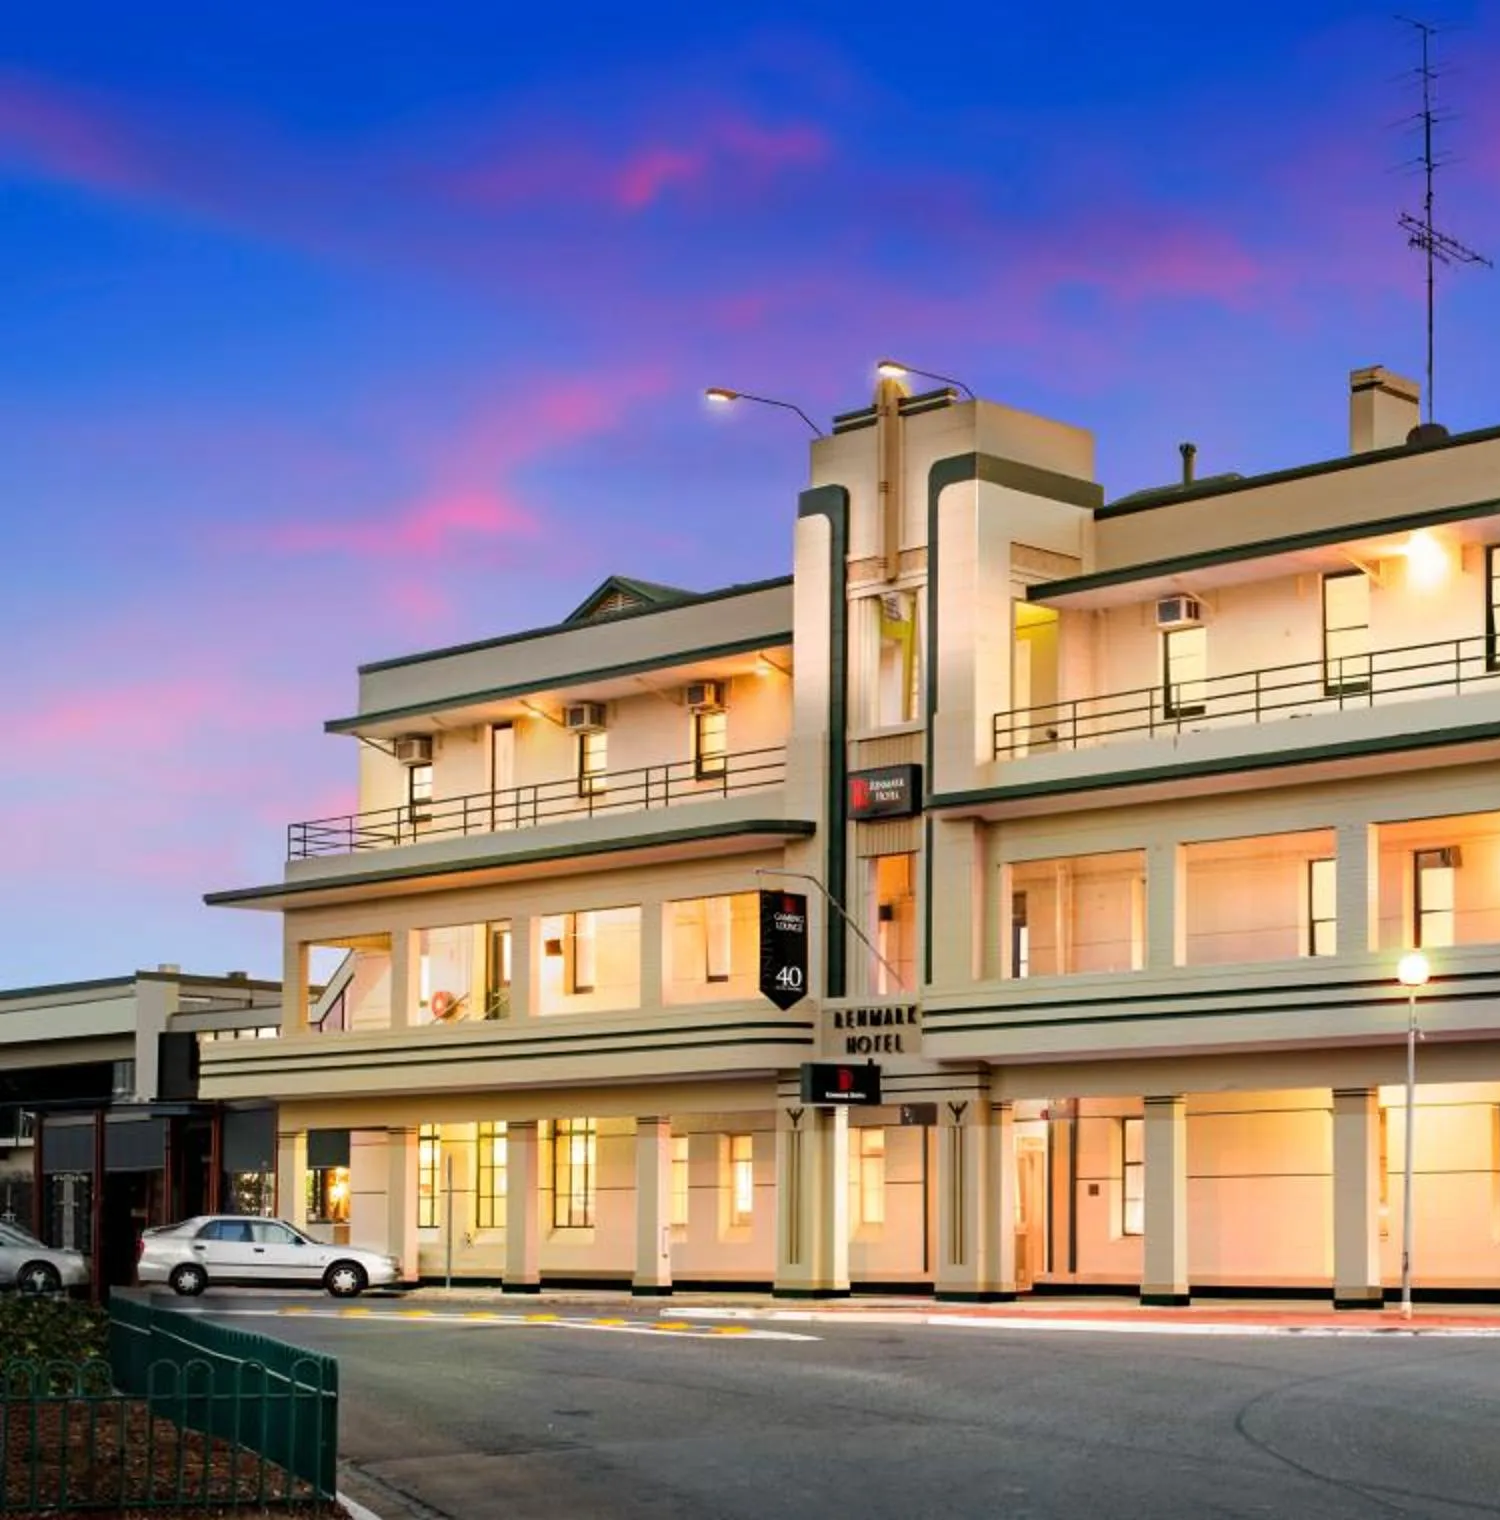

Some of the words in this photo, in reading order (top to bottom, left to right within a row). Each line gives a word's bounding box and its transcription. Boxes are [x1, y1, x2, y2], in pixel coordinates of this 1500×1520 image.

[775, 966, 803, 988] 40
[834, 1005, 917, 1029] RENMARK
[846, 1034, 904, 1055] HOTEL
